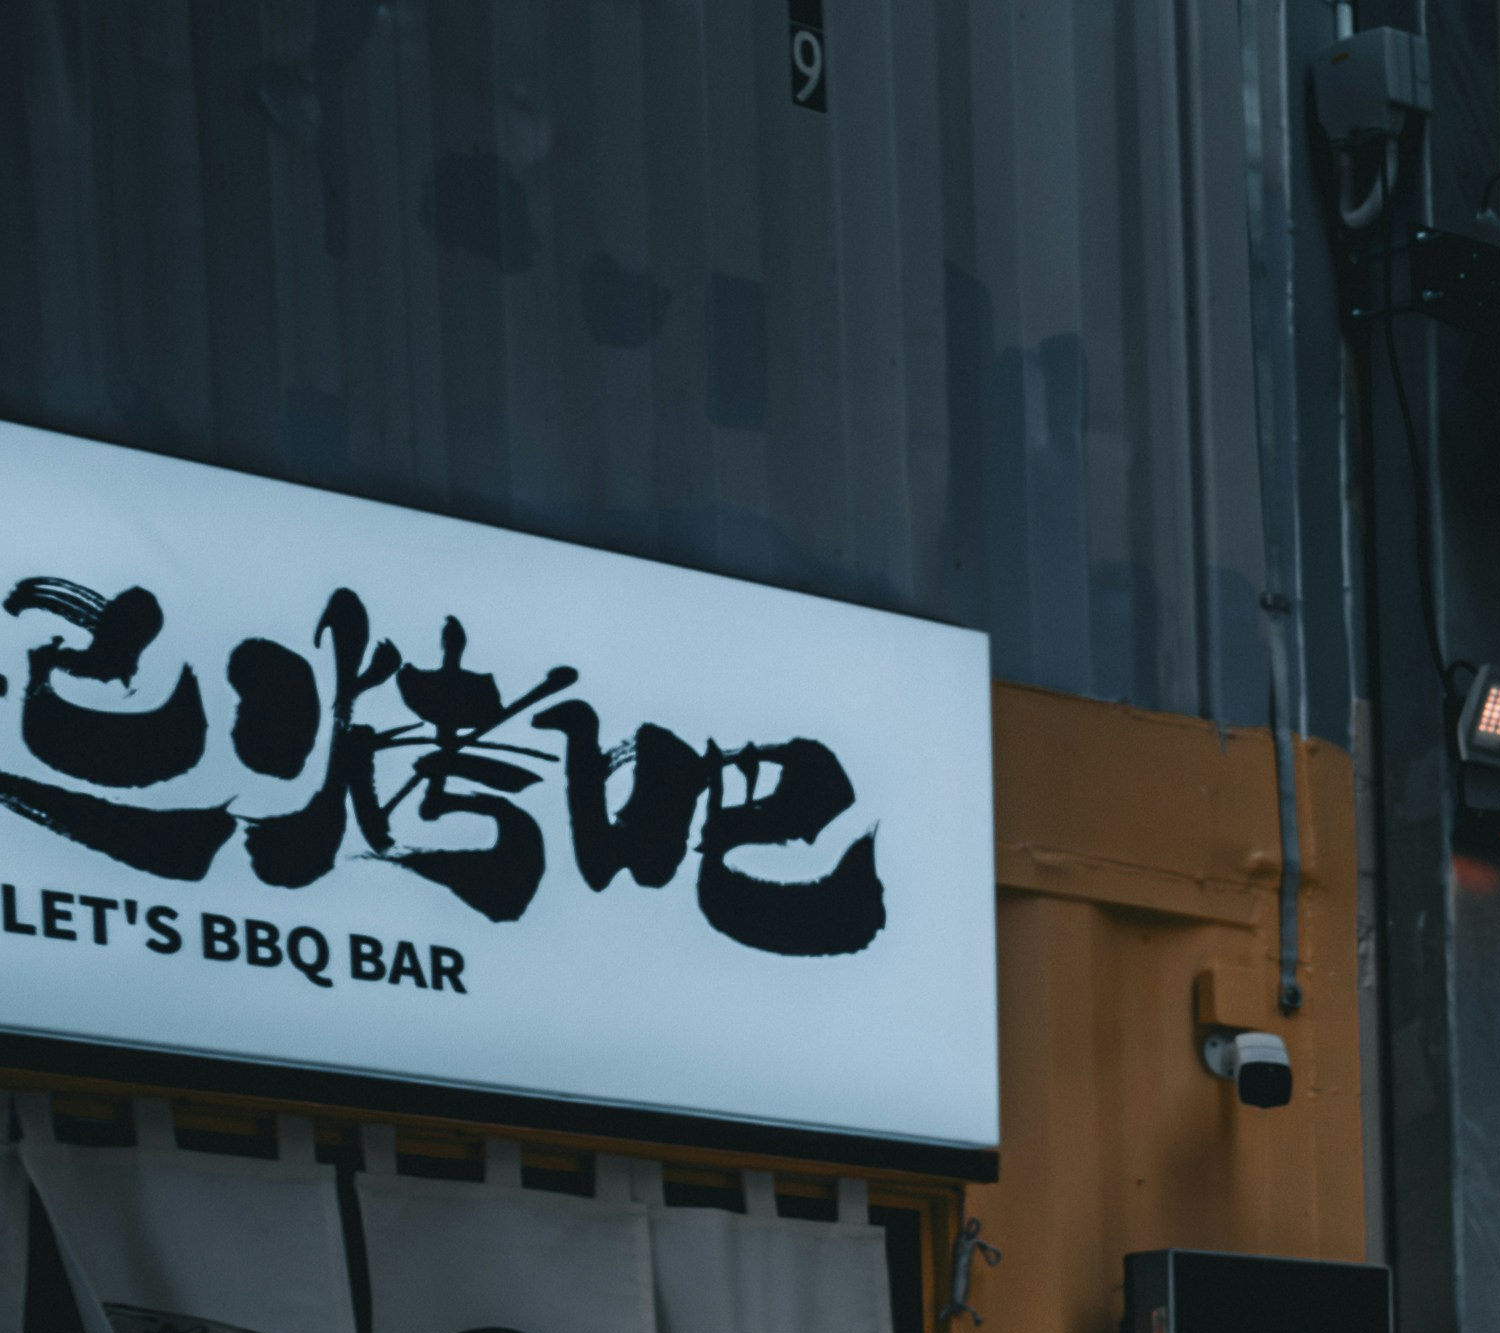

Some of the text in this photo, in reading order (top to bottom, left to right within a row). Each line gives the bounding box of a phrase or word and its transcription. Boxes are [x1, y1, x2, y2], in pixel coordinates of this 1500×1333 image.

[2, 883, 468, 994] LET'S BBQ BAR
